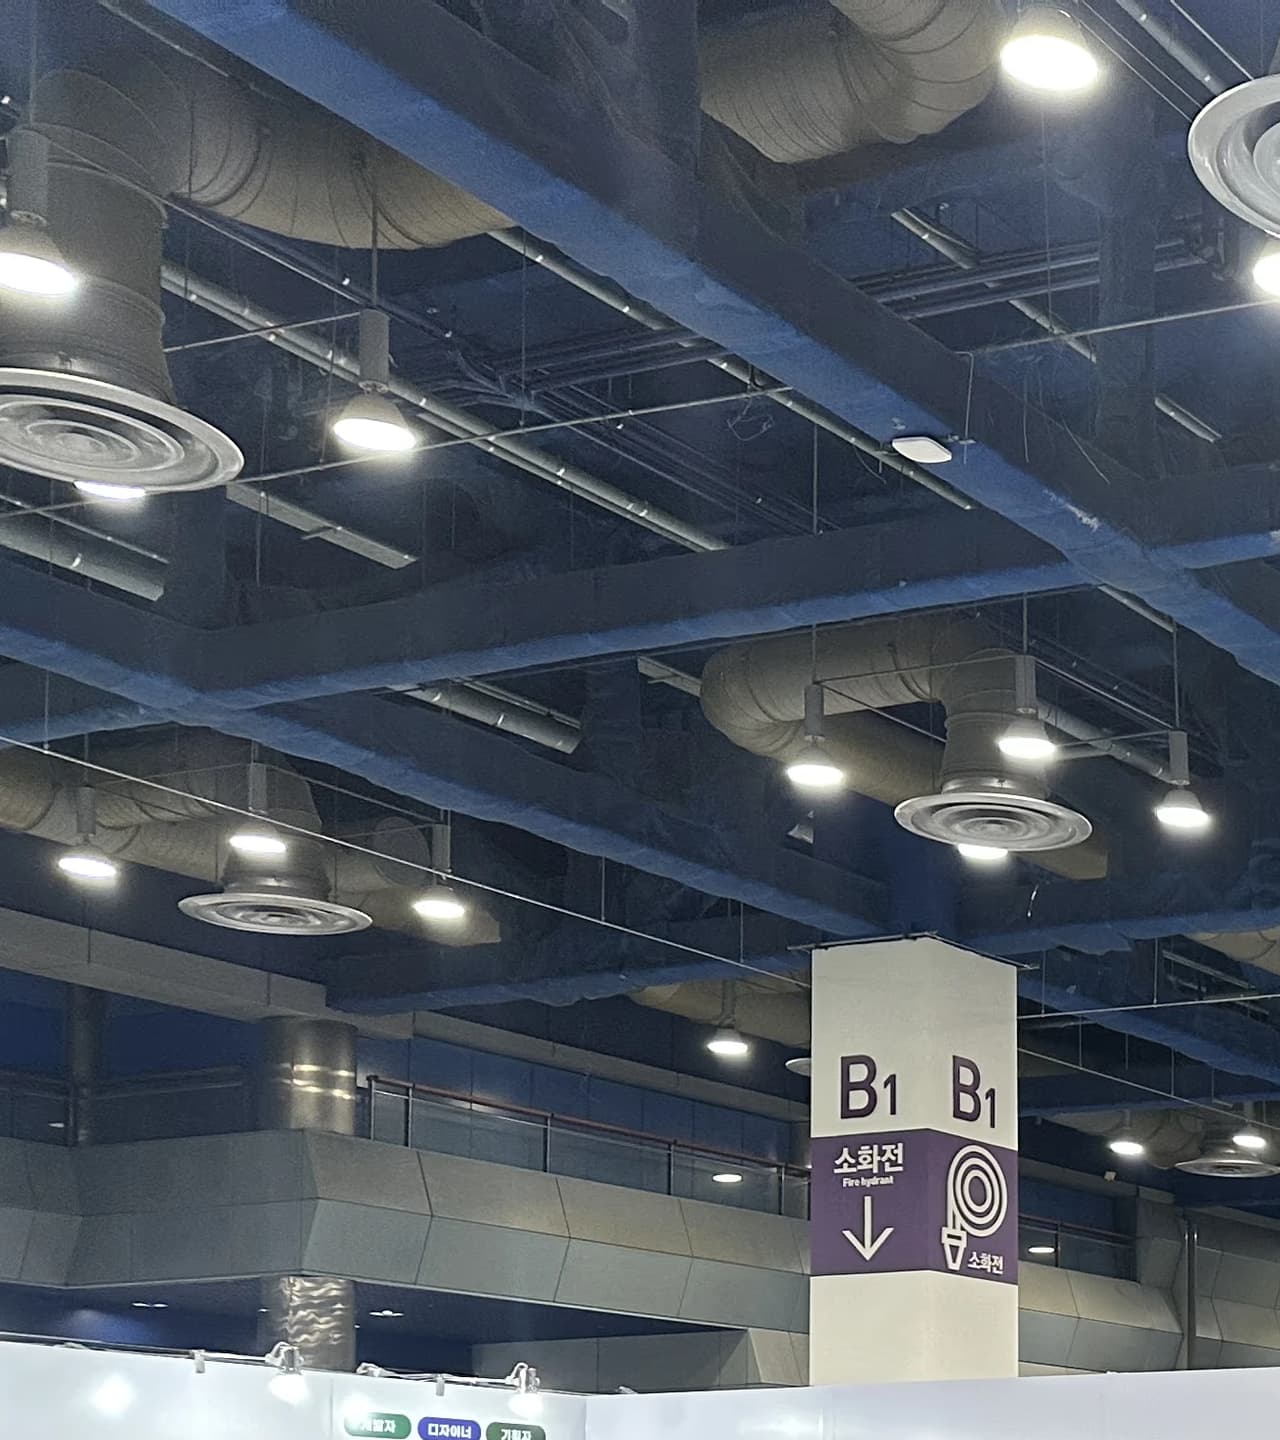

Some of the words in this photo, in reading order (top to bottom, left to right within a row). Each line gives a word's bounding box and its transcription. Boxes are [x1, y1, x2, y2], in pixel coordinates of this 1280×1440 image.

[840, 1054, 897, 1119] B1
[952, 1054, 996, 1128] B1
[833, 1142, 904, 1174] 소화전
[842, 1177, 860, 1187] Fire
[860, 1175, 894, 1188] hydrant
[967, 1251, 1004, 1274] 소화전
[427, 1423, 472, 1439] 디자이너
